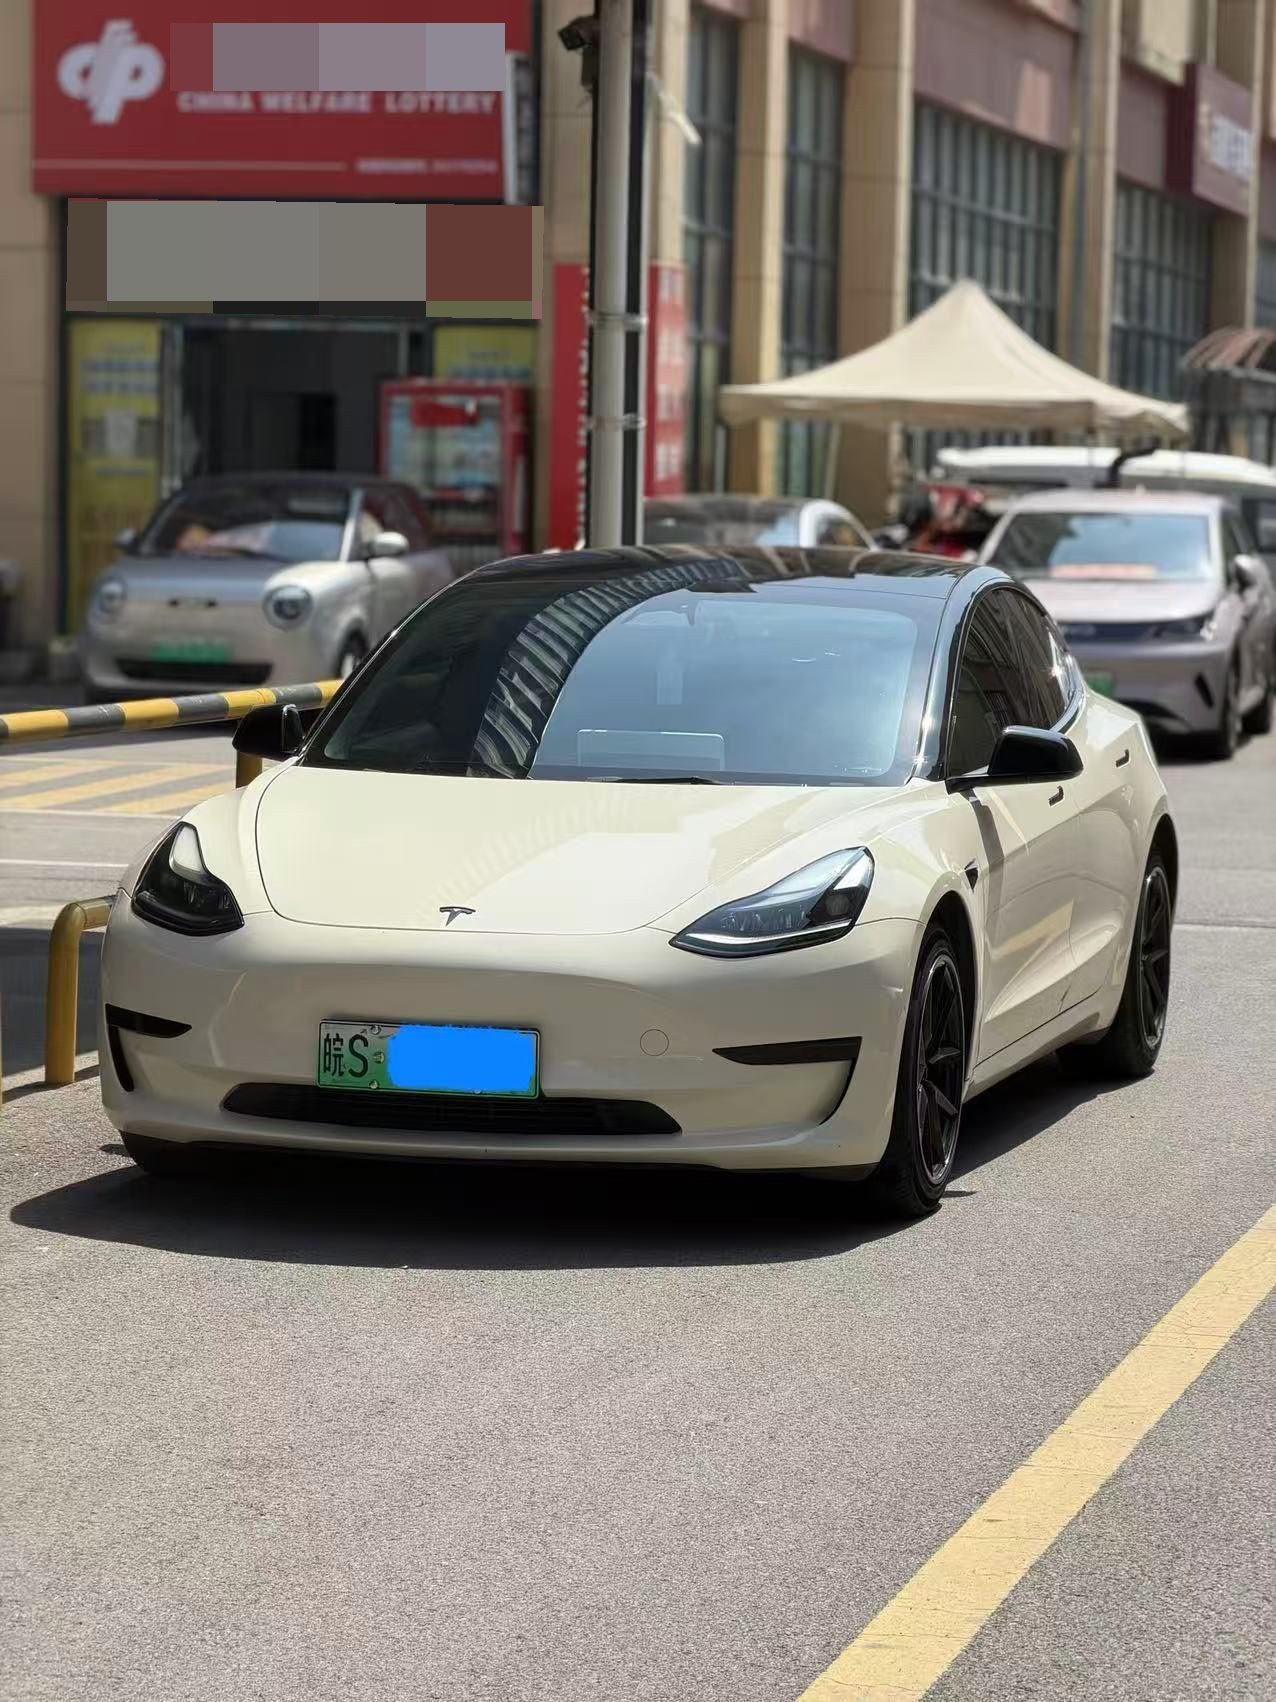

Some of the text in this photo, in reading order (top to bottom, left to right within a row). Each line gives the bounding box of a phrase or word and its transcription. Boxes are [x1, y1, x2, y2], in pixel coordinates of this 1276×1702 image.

[177, 91, 496, 114] CHINA WELFARE LOTTERY
